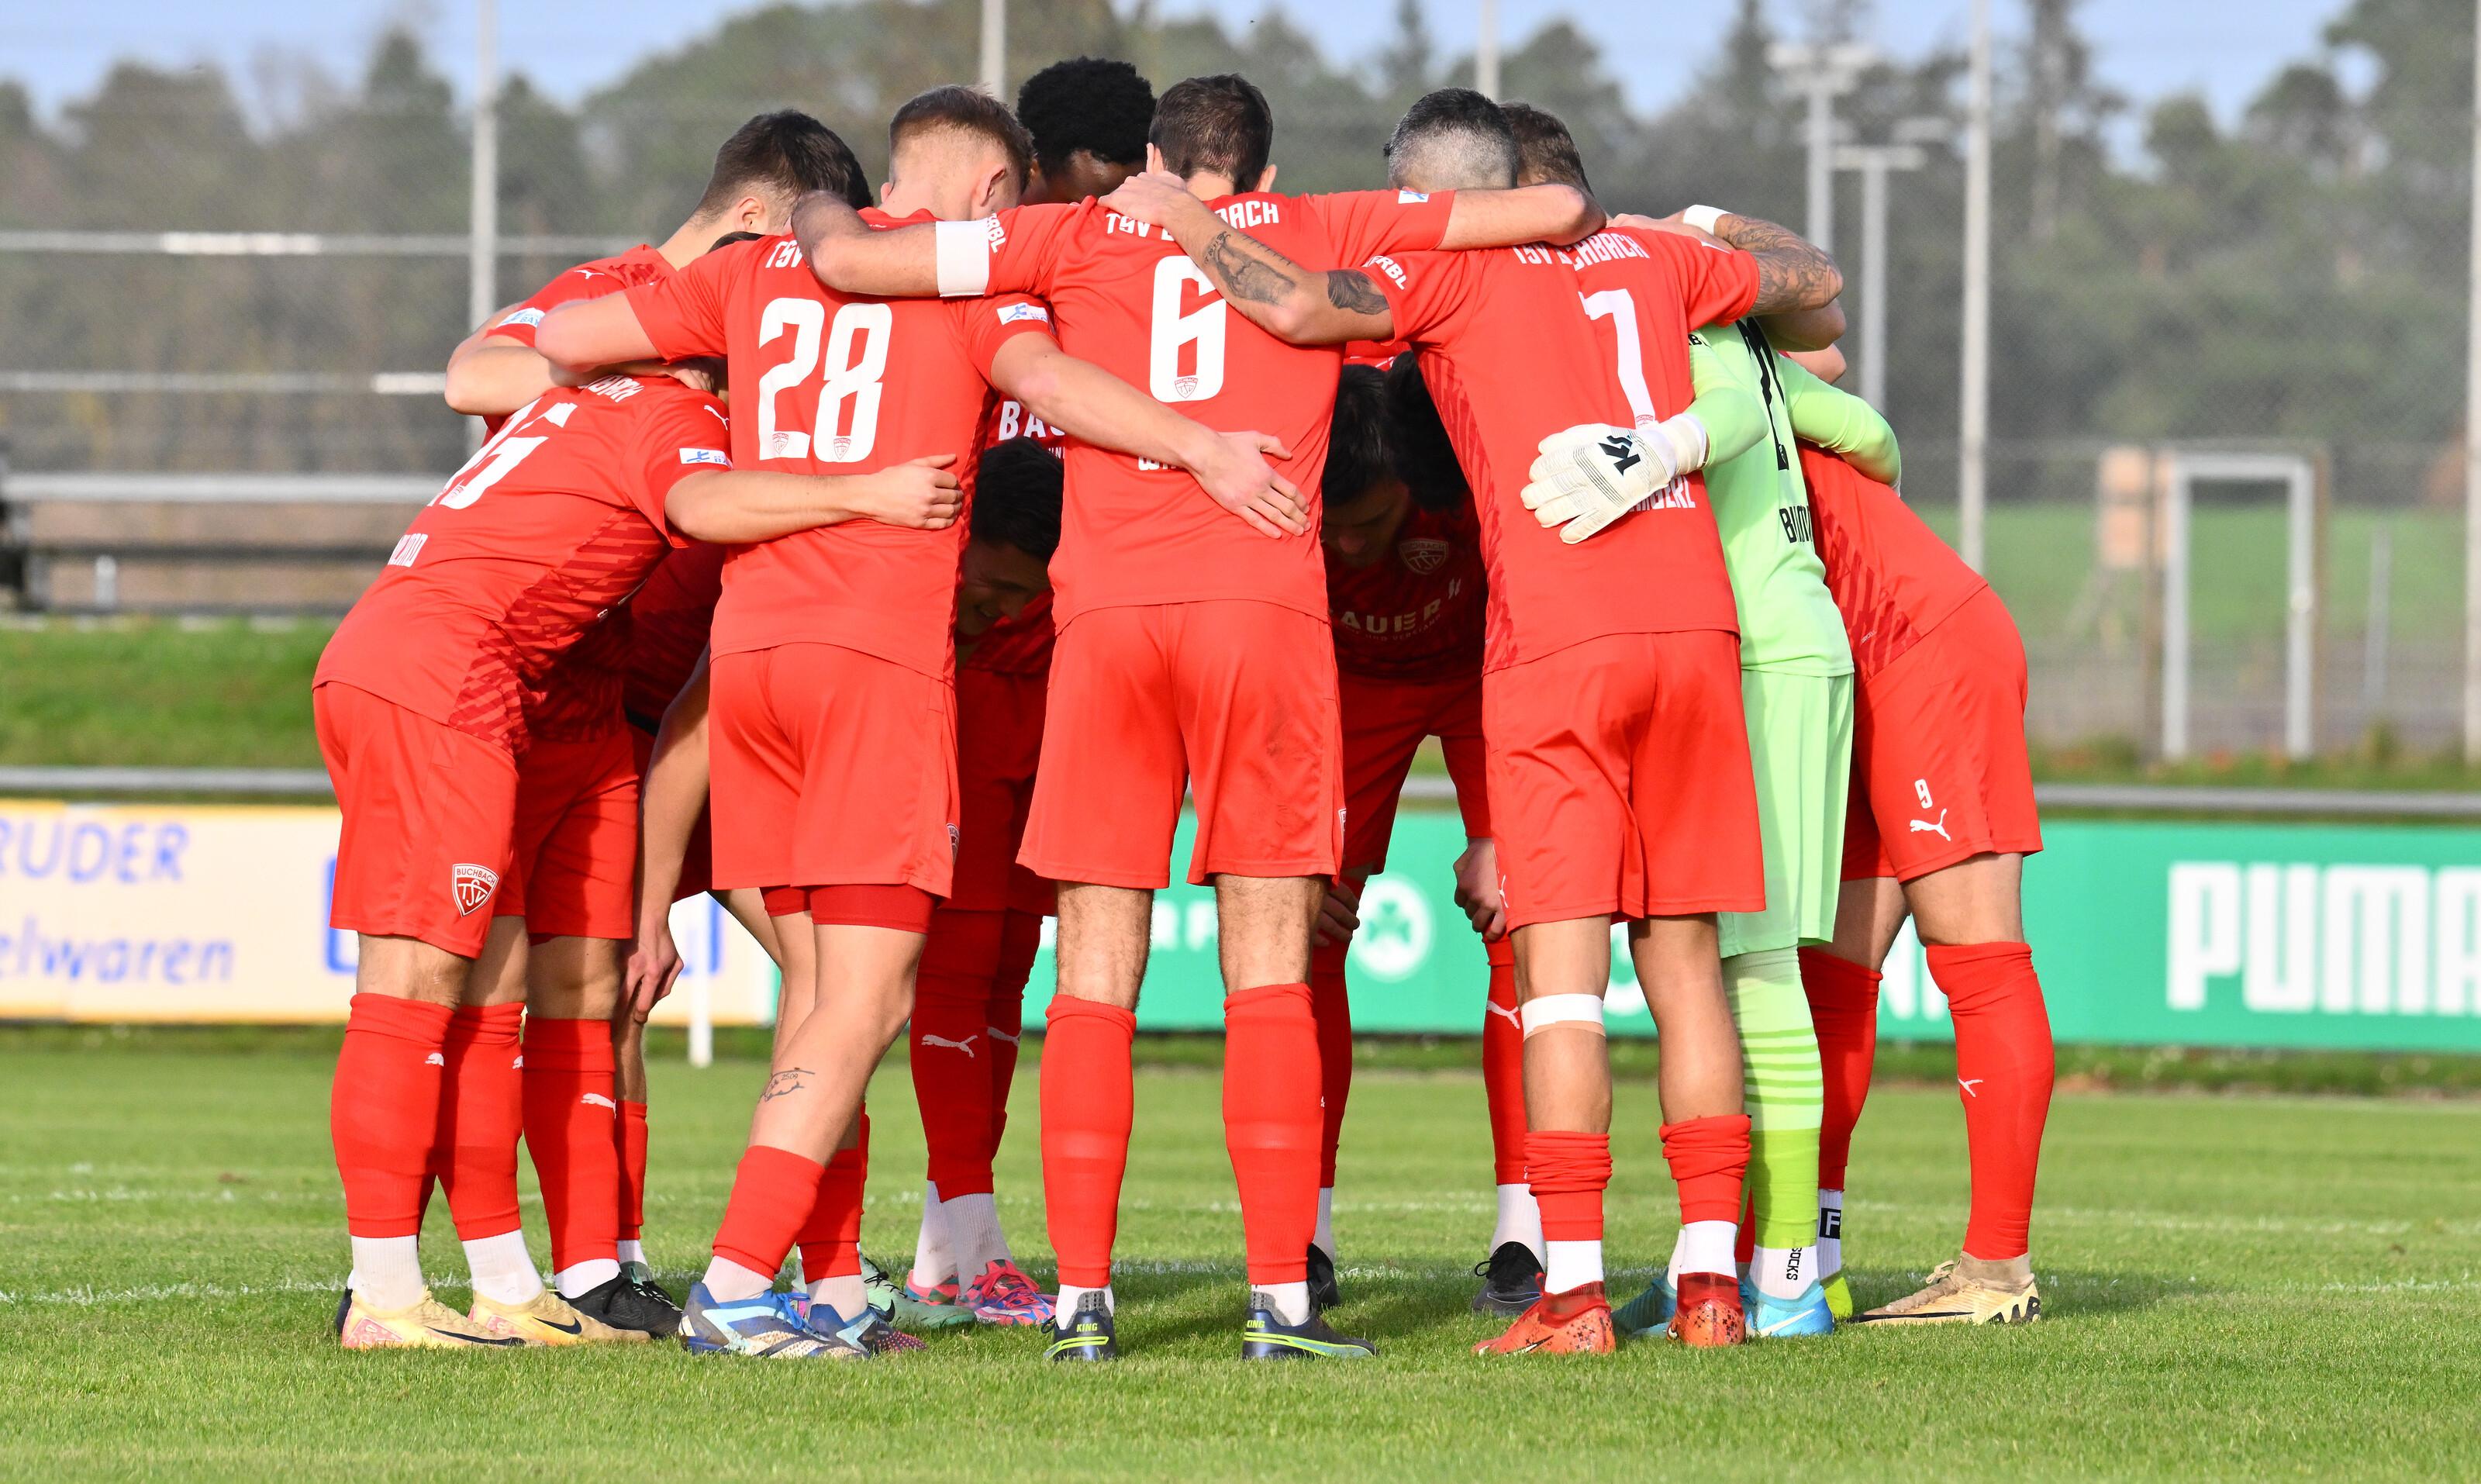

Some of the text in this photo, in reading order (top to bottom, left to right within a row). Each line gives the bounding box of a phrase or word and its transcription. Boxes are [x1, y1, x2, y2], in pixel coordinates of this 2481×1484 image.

[1150, 255, 1227, 403] 6
[1578, 288, 1656, 431] 7
[758, 297, 892, 463] 28
[999, 401, 1065, 441] BA
[1914, 778, 1933, 809] 9
[457, 868, 496, 885] BUCHBACH
[457, 879, 488, 906] TSV
[2167, 862, 2481, 1017] PUMA
[1076, 1323, 1098, 1332] KING
